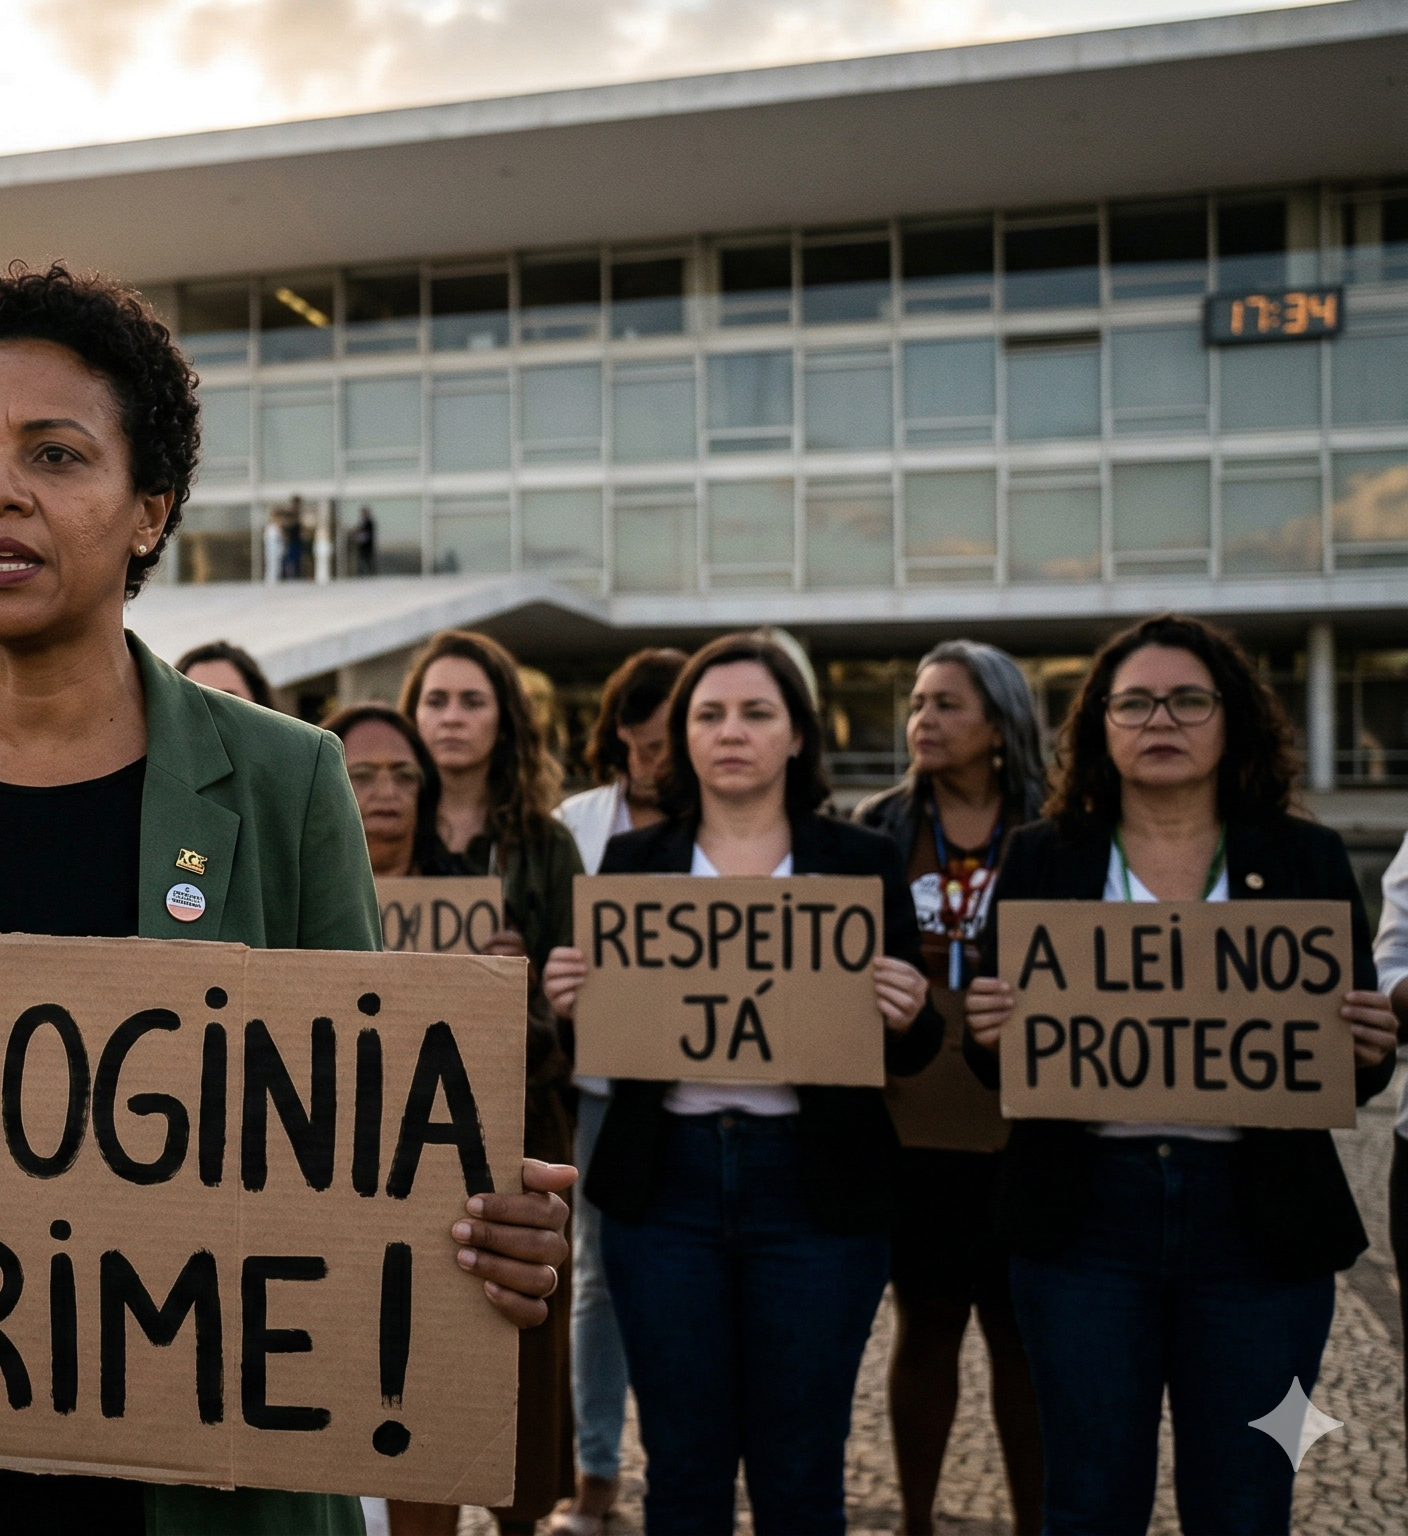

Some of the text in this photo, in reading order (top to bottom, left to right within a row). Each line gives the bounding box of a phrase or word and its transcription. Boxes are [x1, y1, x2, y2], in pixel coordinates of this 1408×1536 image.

[1230, 291, 1338, 336] 17:34
[593, 892, 877, 974] RESPEITO
[1017, 912, 1344, 997] A LEI NOS
[679, 978, 774, 1063] JÁ
[1024, 1013, 1325, 1095] PROTEGE
